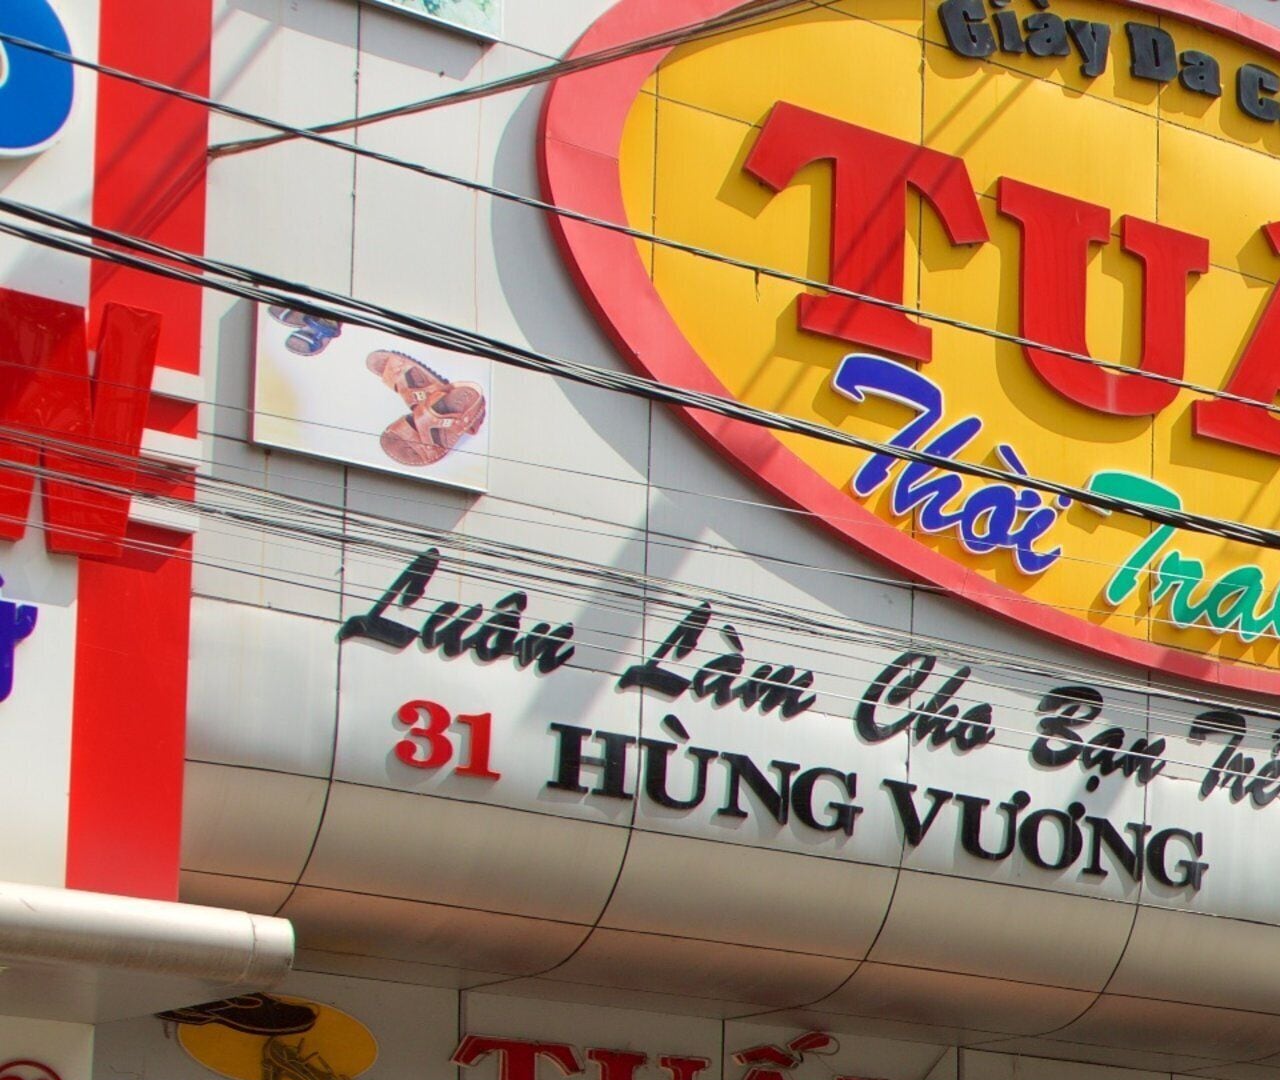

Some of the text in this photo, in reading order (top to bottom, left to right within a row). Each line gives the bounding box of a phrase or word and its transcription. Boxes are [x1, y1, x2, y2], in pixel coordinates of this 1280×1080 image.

[938, 0, 1110, 78] Giày
[1128, 22, 1222, 98] Da
[832, 353, 1072, 576] Thời
[339, 547, 576, 675] Luôn
[619, 601, 817, 720] Làm
[854, 650, 996, 751] Cho
[1031, 685, 1167, 793] Bạn
[397, 700, 1210, 892] 31 HÙNG VƯƠNG
